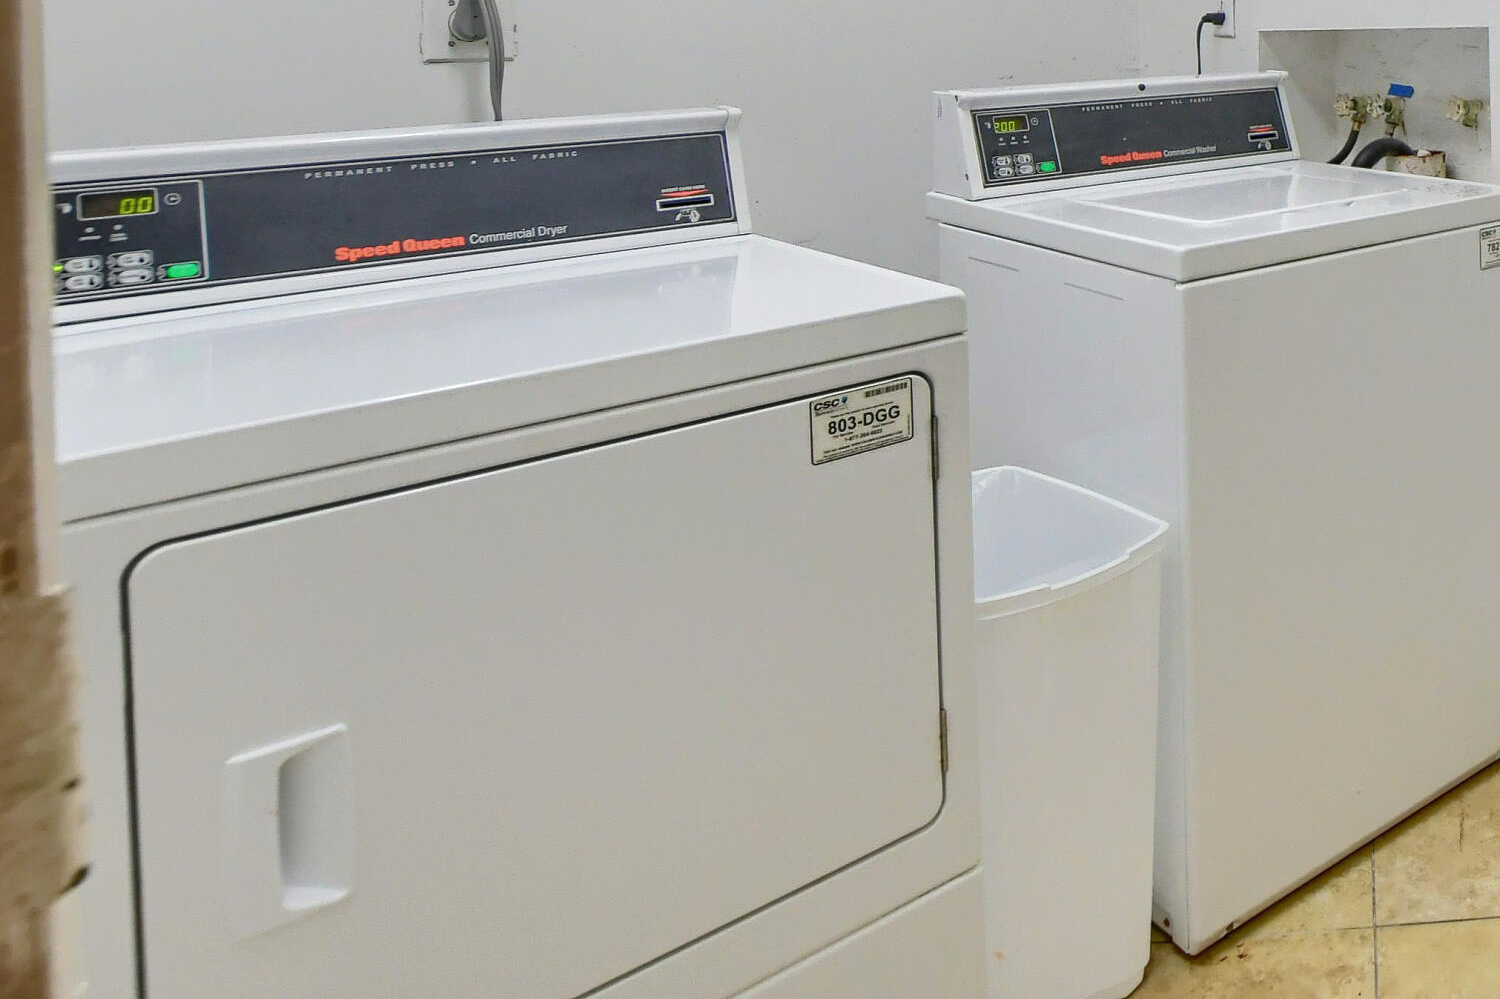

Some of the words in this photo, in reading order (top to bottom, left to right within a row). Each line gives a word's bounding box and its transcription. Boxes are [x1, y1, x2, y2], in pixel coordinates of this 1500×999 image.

[1081, 104, 1124, 112] PERMANENT
[304, 166, 393, 180] PERMANENT
[410, 160, 456, 171] PRESS
[492, 156, 517, 164] ALL
[532, 150, 579, 161] FABRIC
[1100, 152, 1132, 165] Speed
[1132, 149, 1163, 161] Queen
[1163, 146, 1196, 157] Commercial
[1195, 144, 1217, 153] Washer
[119, 196, 153, 215] 00
[334, 240, 400, 262] Speed
[402, 235, 466, 253] Queen
[469, 226, 535, 245] Commercial
[537, 223, 569, 238] Dryer
[814, 398, 841, 411] CSC
[828, 404, 901, 435] 803-DGG
